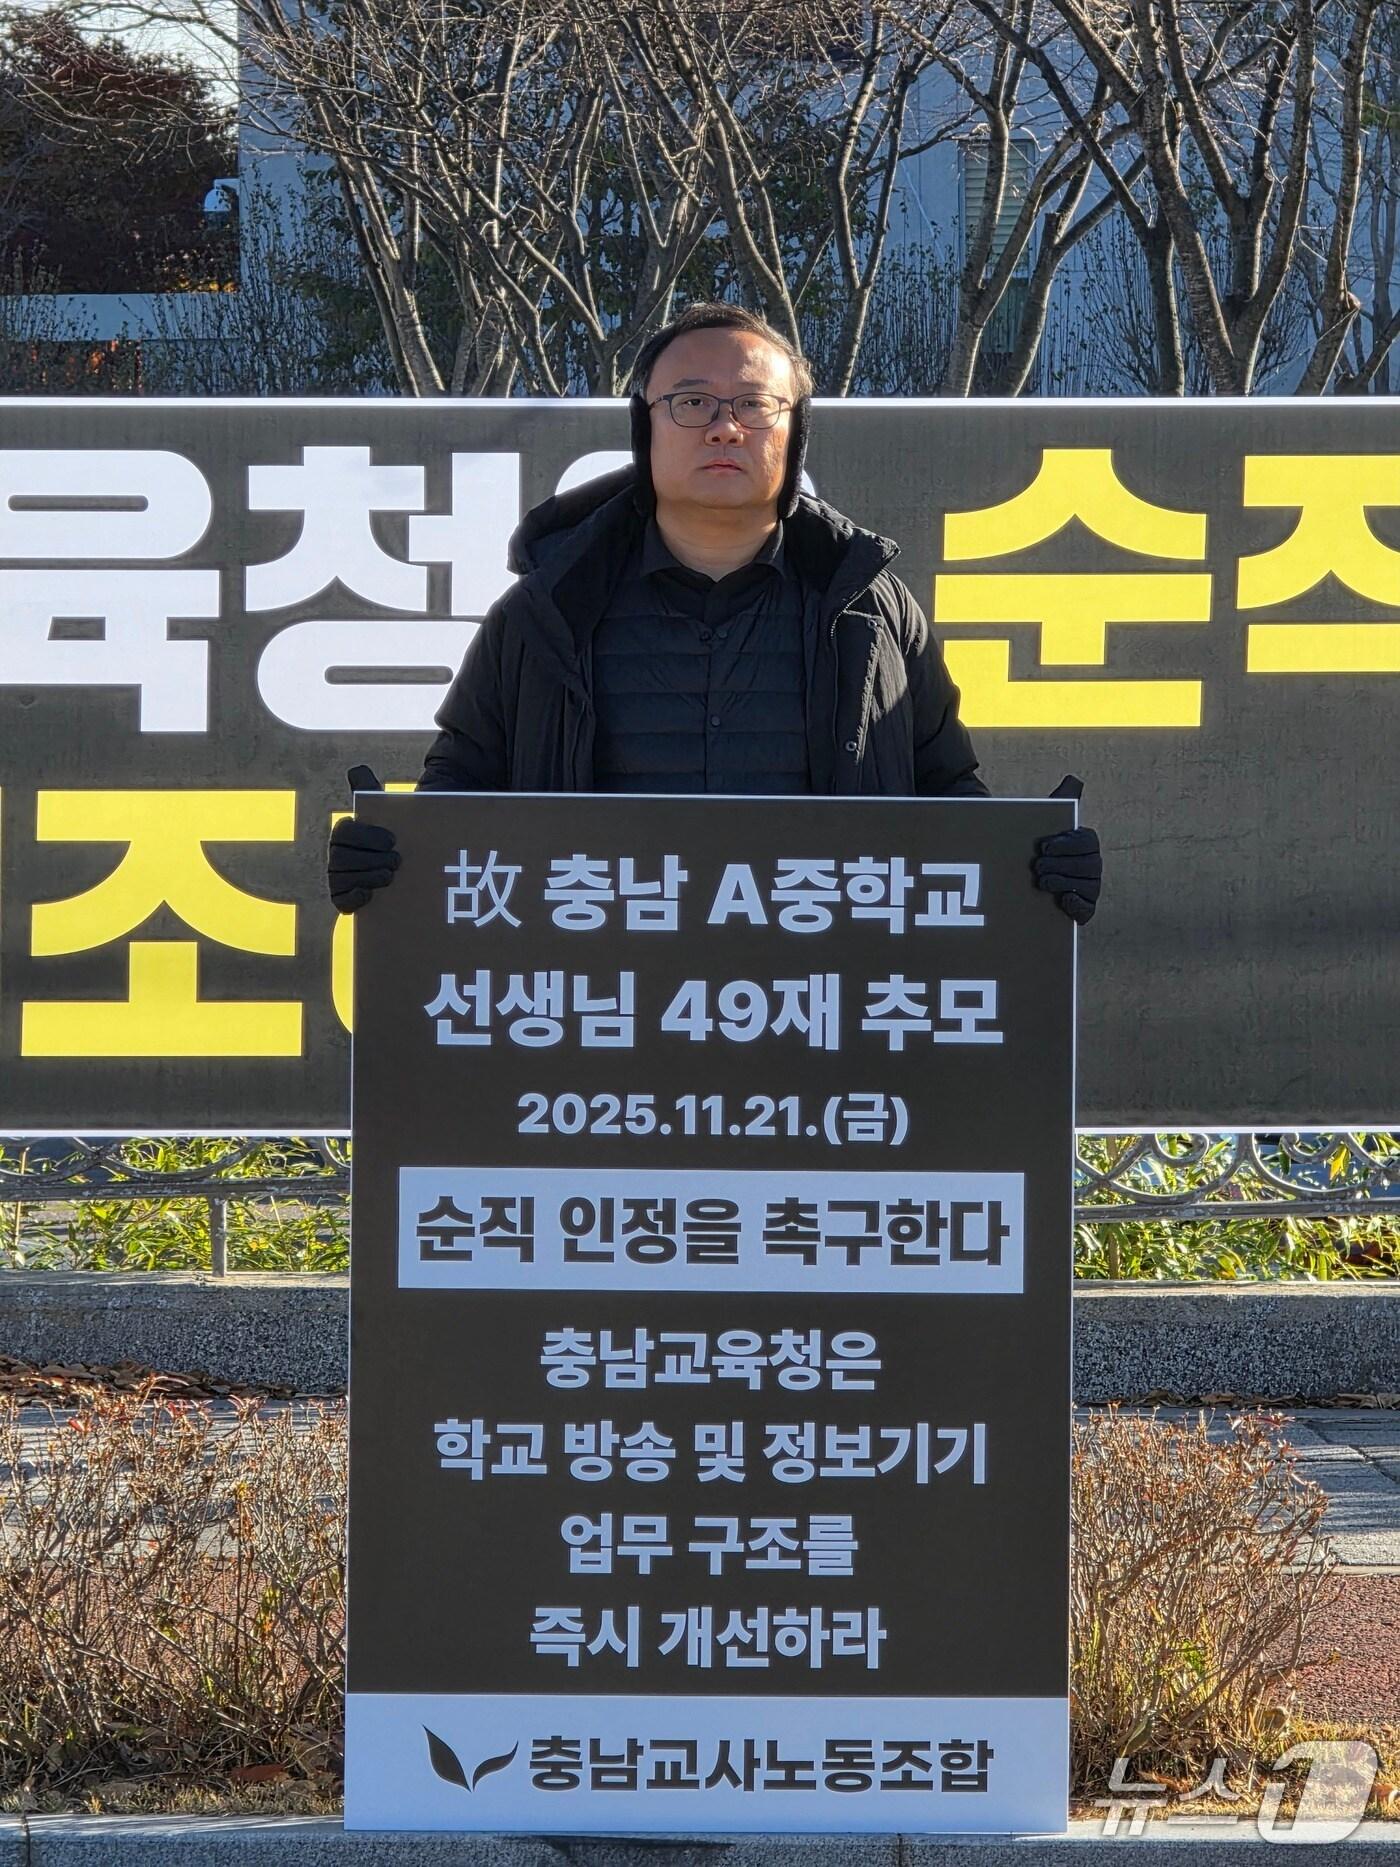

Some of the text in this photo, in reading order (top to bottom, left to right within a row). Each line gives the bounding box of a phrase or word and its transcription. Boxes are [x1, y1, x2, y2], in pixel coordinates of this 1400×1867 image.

[0, 446, 817, 732] 육청
[445, 850, 985, 934] 故 충남 A중학교
[424, 969, 1004, 1051] 선생님 49재 추모
[517, 1092, 909, 1146] 2025.11.21.(금)
[416, 1195, 1011, 1266] 순직 인정을 촉구한다
[540, 1327, 882, 1391] 충남교육청은
[433, 1418, 986, 1485] 학교 방송 및 정보기기
[560, 1512, 859, 1576] 업무 구조를
[529, 1605, 888, 1670] 즉시 개선하라
[529, 1735, 995, 1793] 충남교사노동조합
